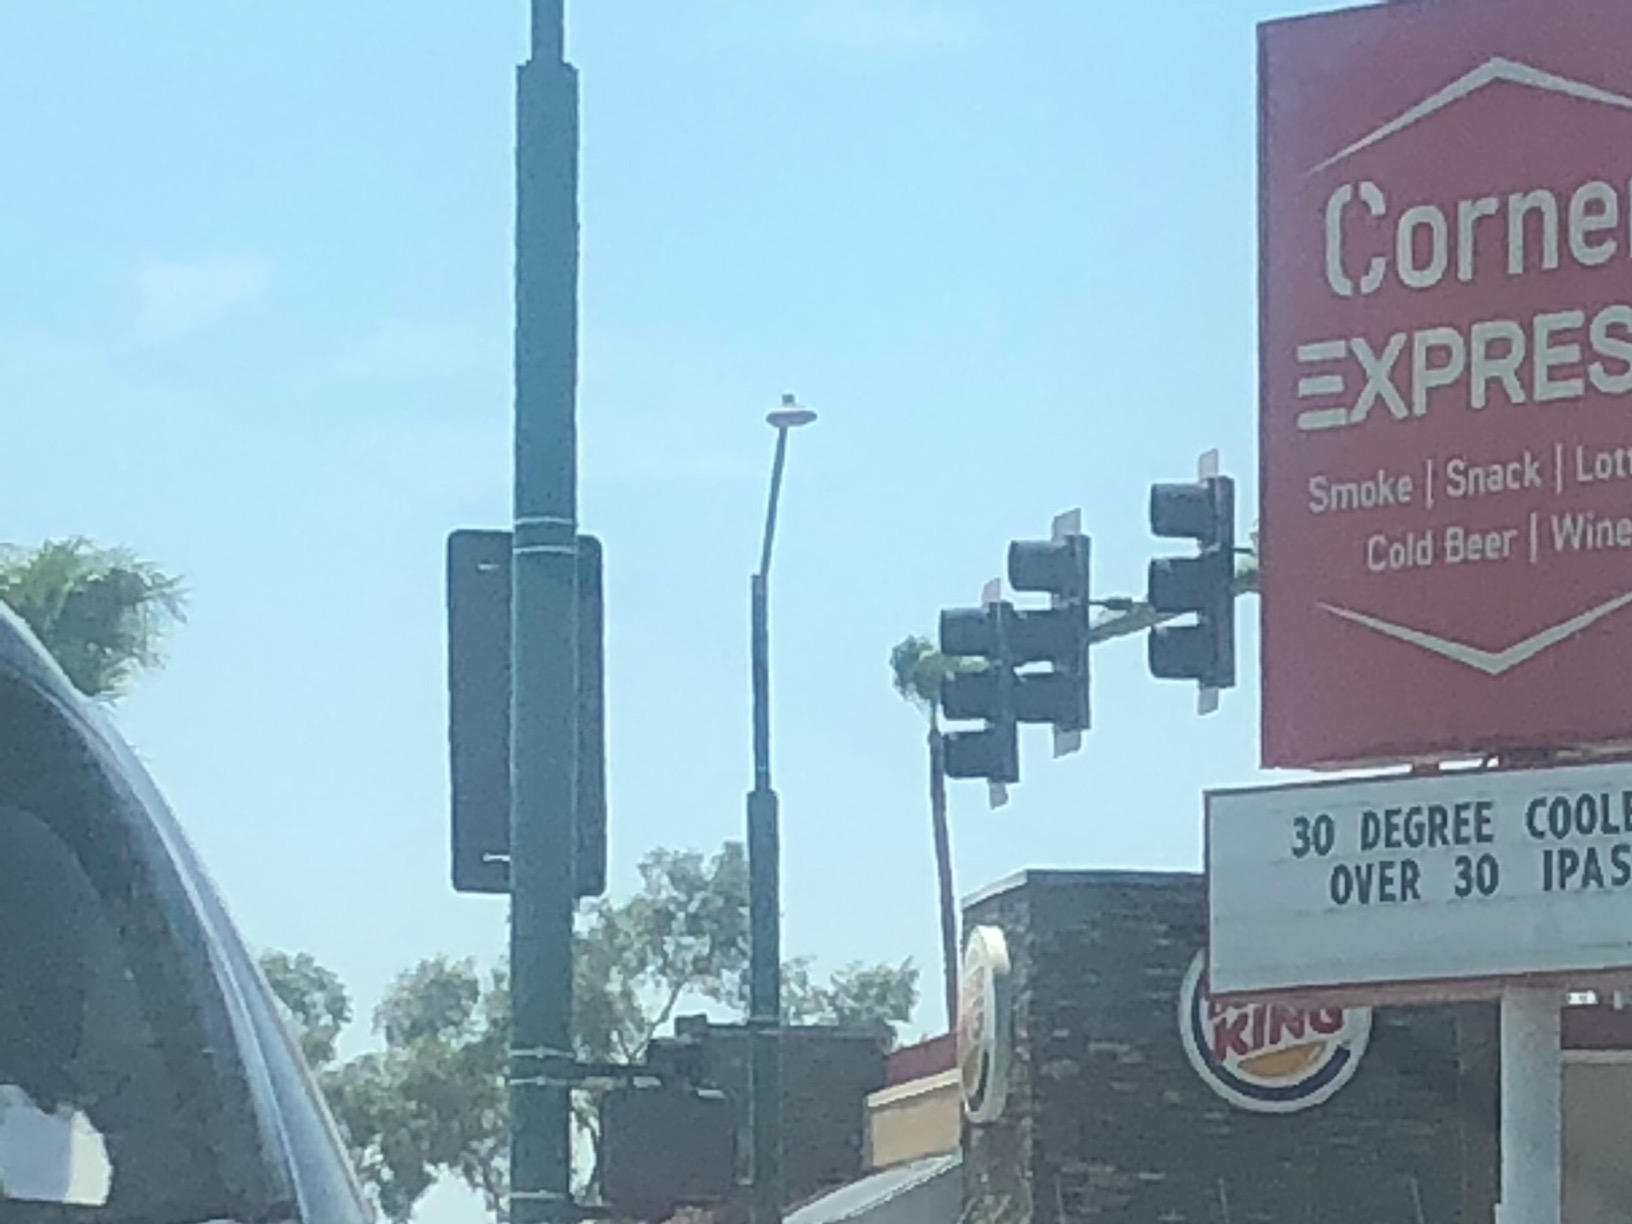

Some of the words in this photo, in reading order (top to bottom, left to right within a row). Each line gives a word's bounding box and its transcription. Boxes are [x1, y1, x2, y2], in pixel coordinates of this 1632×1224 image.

[1308, 469, 1414, 513] Smoke
[1446, 451, 1542, 497] Snack
[1368, 529, 1433, 571] Cold
[1444, 526, 1518, 563] Beer
[1292, 814, 1335, 858] 30
[1361, 802, 1494, 852] DEGREE
[1330, 862, 1421, 905] OVER
[1454, 854, 1499, 898] 30
[1543, 844, 1632, 892] IPAS
[1214, 1003, 1342, 1063] KING
